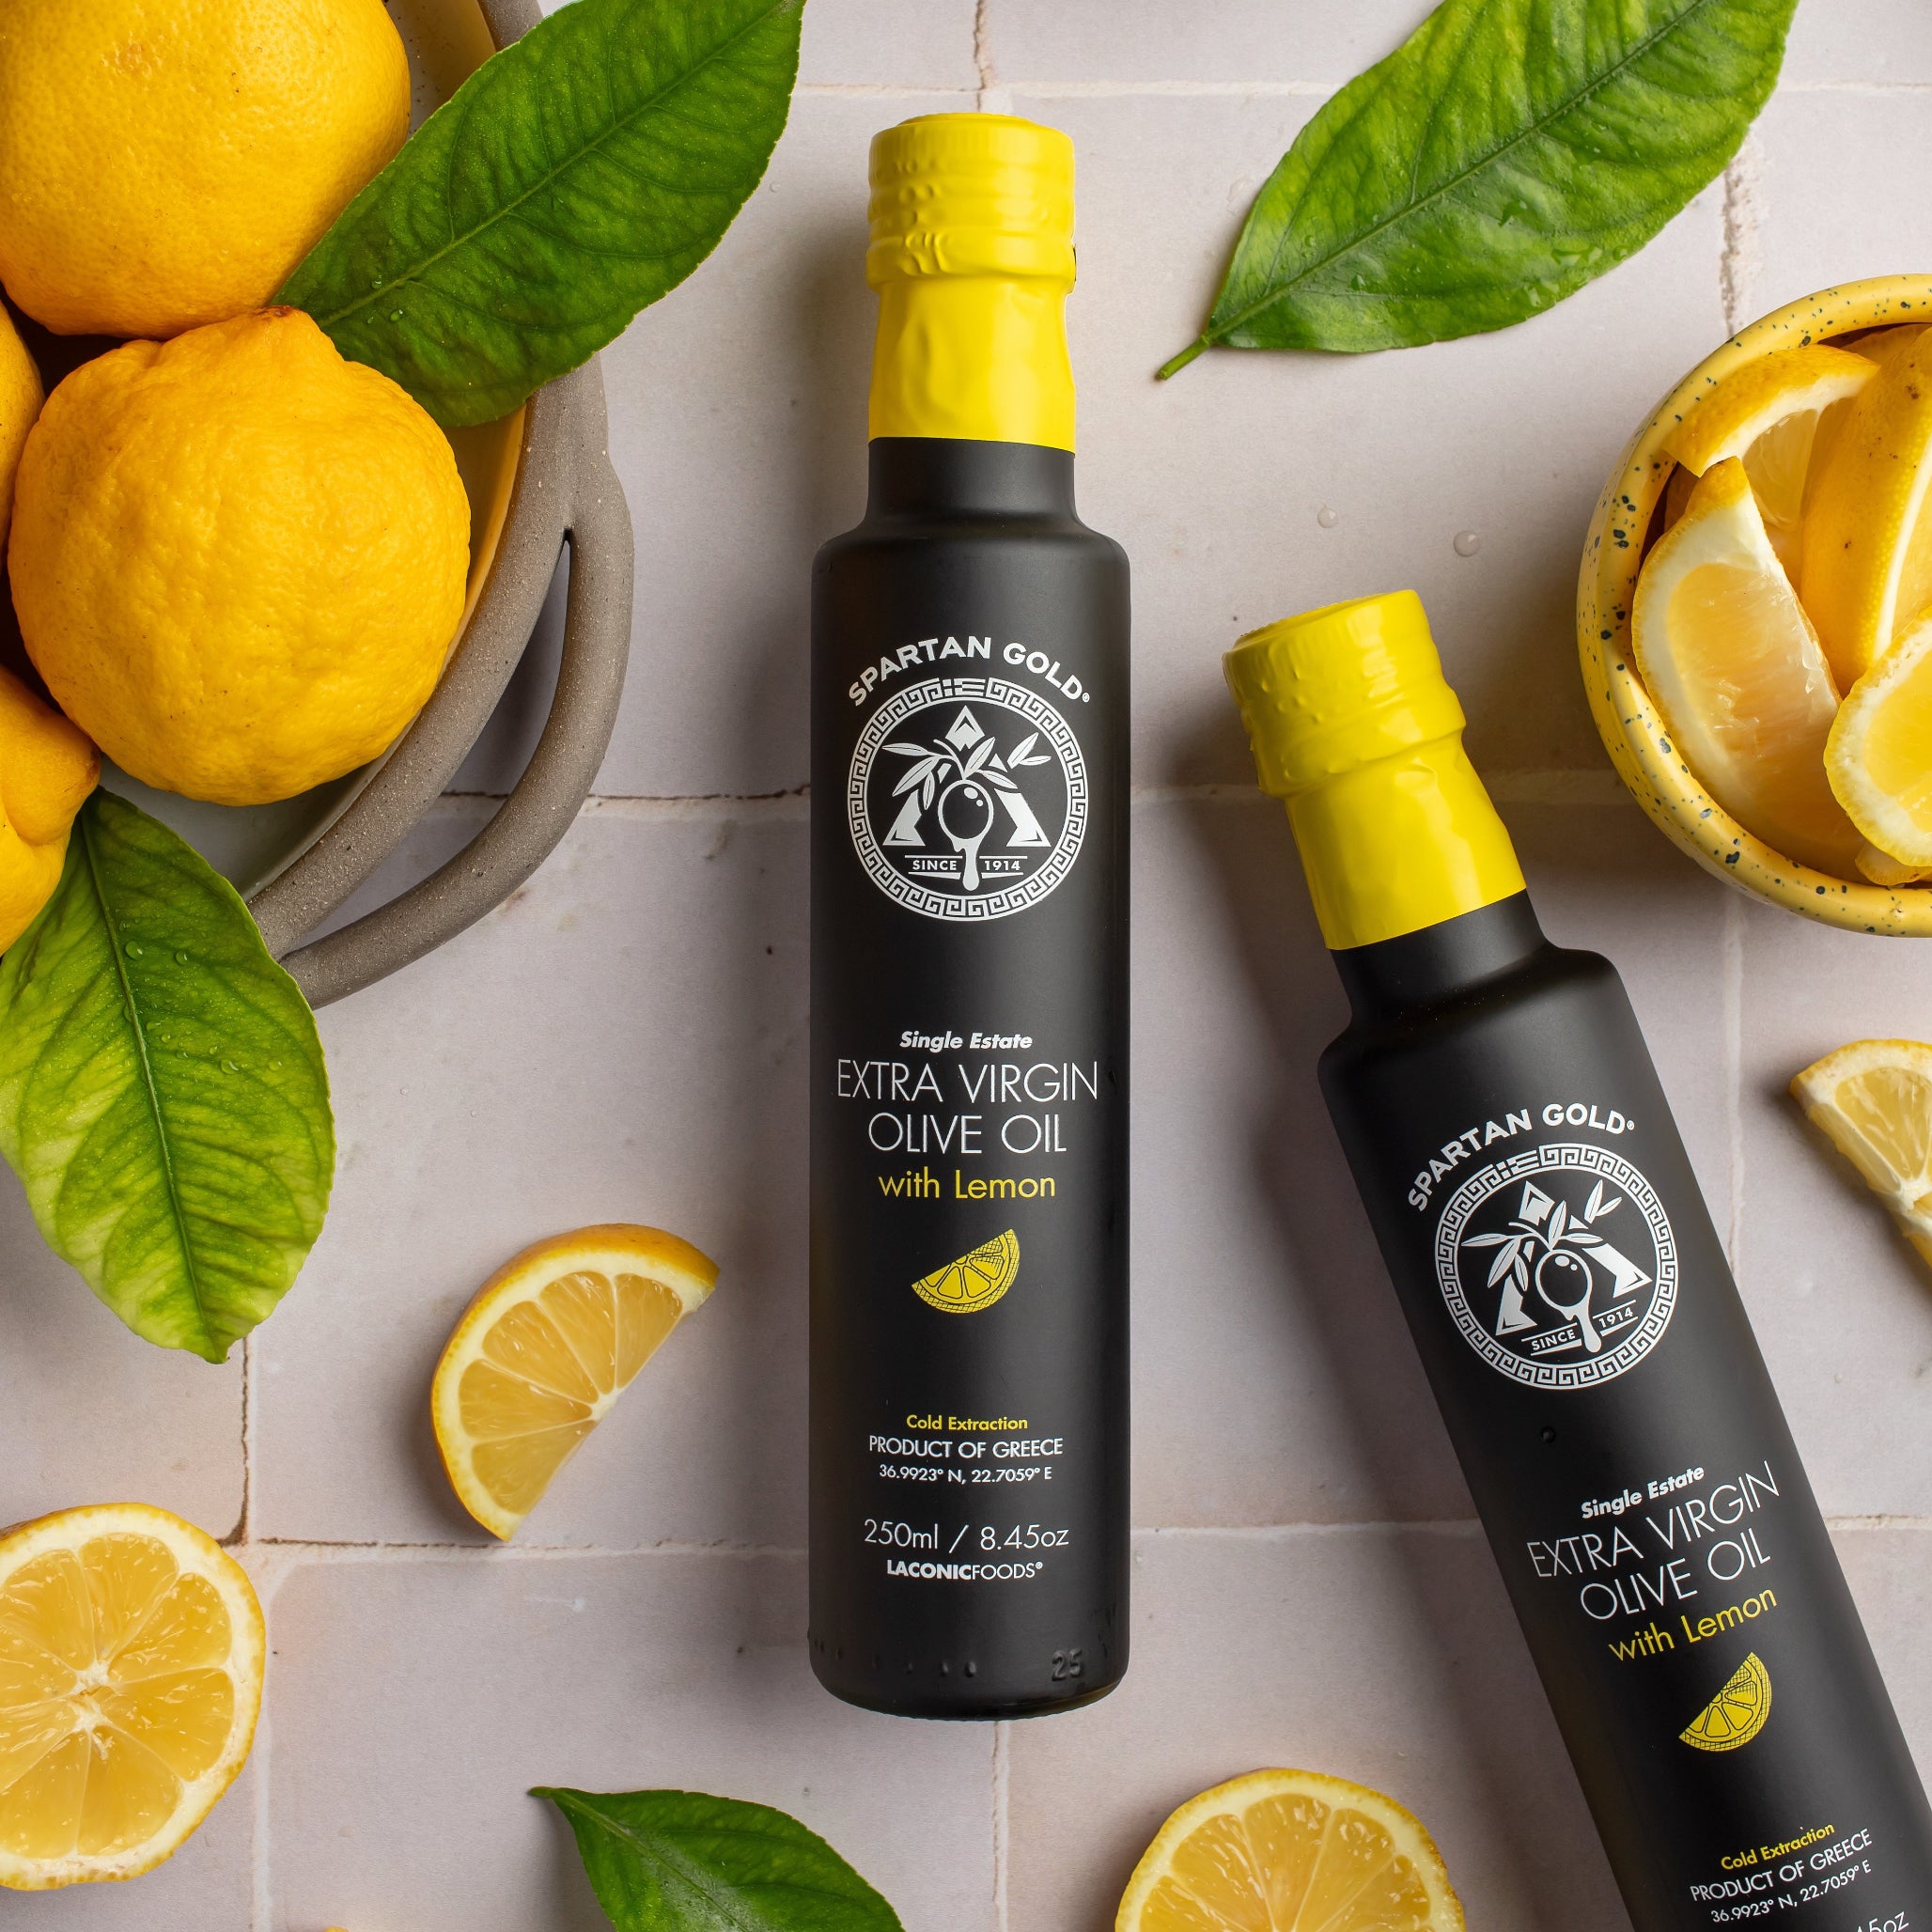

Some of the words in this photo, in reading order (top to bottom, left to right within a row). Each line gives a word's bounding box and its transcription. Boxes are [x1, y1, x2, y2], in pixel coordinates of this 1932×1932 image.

[849, 636, 991, 706] SPARTAN
[912, 860, 957, 872] SINCE
[985, 860, 1021, 872] 1914
[900, 1031, 962, 1052] Single
[970, 1033, 1033, 1049] Estate
[838, 1059, 943, 1101] EXTRA
[958, 1062, 1097, 1103] VIRGIN
[869, 1113, 982, 1154] OLIVE
[1002, 1114, 1067, 1154] OIL
[1409, 1109, 1532, 1210] SPARTAN
[879, 1167, 939, 1197] with
[956, 1170, 1055, 1198] Lemon
[1531, 1330, 1576, 1350] SINCE
[1599, 1307, 1634, 1329] 1914
[907, 1415, 942, 1429] Cold
[949, 1417, 1027, 1430] Extraction
[870, 1436, 952, 1457] PRODUCT
[958, 1441, 986, 1458] OF
[992, 1438, 1063, 1458] GREECE
[880, 1465, 943, 1481] 36.9923°
[948, 1470, 966, 1485] N,
[972, 1468, 1040, 1482] 22.7059°
[1045, 1467, 1052, 1479] E
[1581, 1489, 1642, 1518] Single
[1647, 1467, 1704, 1499] Estate
[865, 1519, 938, 1549] 250ml
[949, 1525, 969, 1553] /
[981, 1524, 1068, 1550] 8.45oz
[1527, 1527, 1644, 1576] EXTRA
[1645, 1460, 1779, 1550] VIRGIN
[1581, 1558, 1697, 1619] OLIVE
[1707, 1528, 1770, 1581] OIL
[1609, 1623, 1675, 1660] with
[1681, 1590, 1777, 1643] Lemon
[1690, 1871, 1773, 1900] PRODUCT
[1780, 1861, 1804, 1881] OF
[1810, 1829, 1872, 1870] GREECE
[1722, 1849, 1757, 1869] Cold
[1760, 1825, 1834, 1860] Extraction
[1711, 1900, 1773, 1922] 36.9923°
[1778, 1894, 1797, 1909] N,
[1800, 1865, 1859, 1901] 22.7059°
[1862, 1860, 1871, 1873] E
[1858, 1911, 1909, 1932] 5oz
